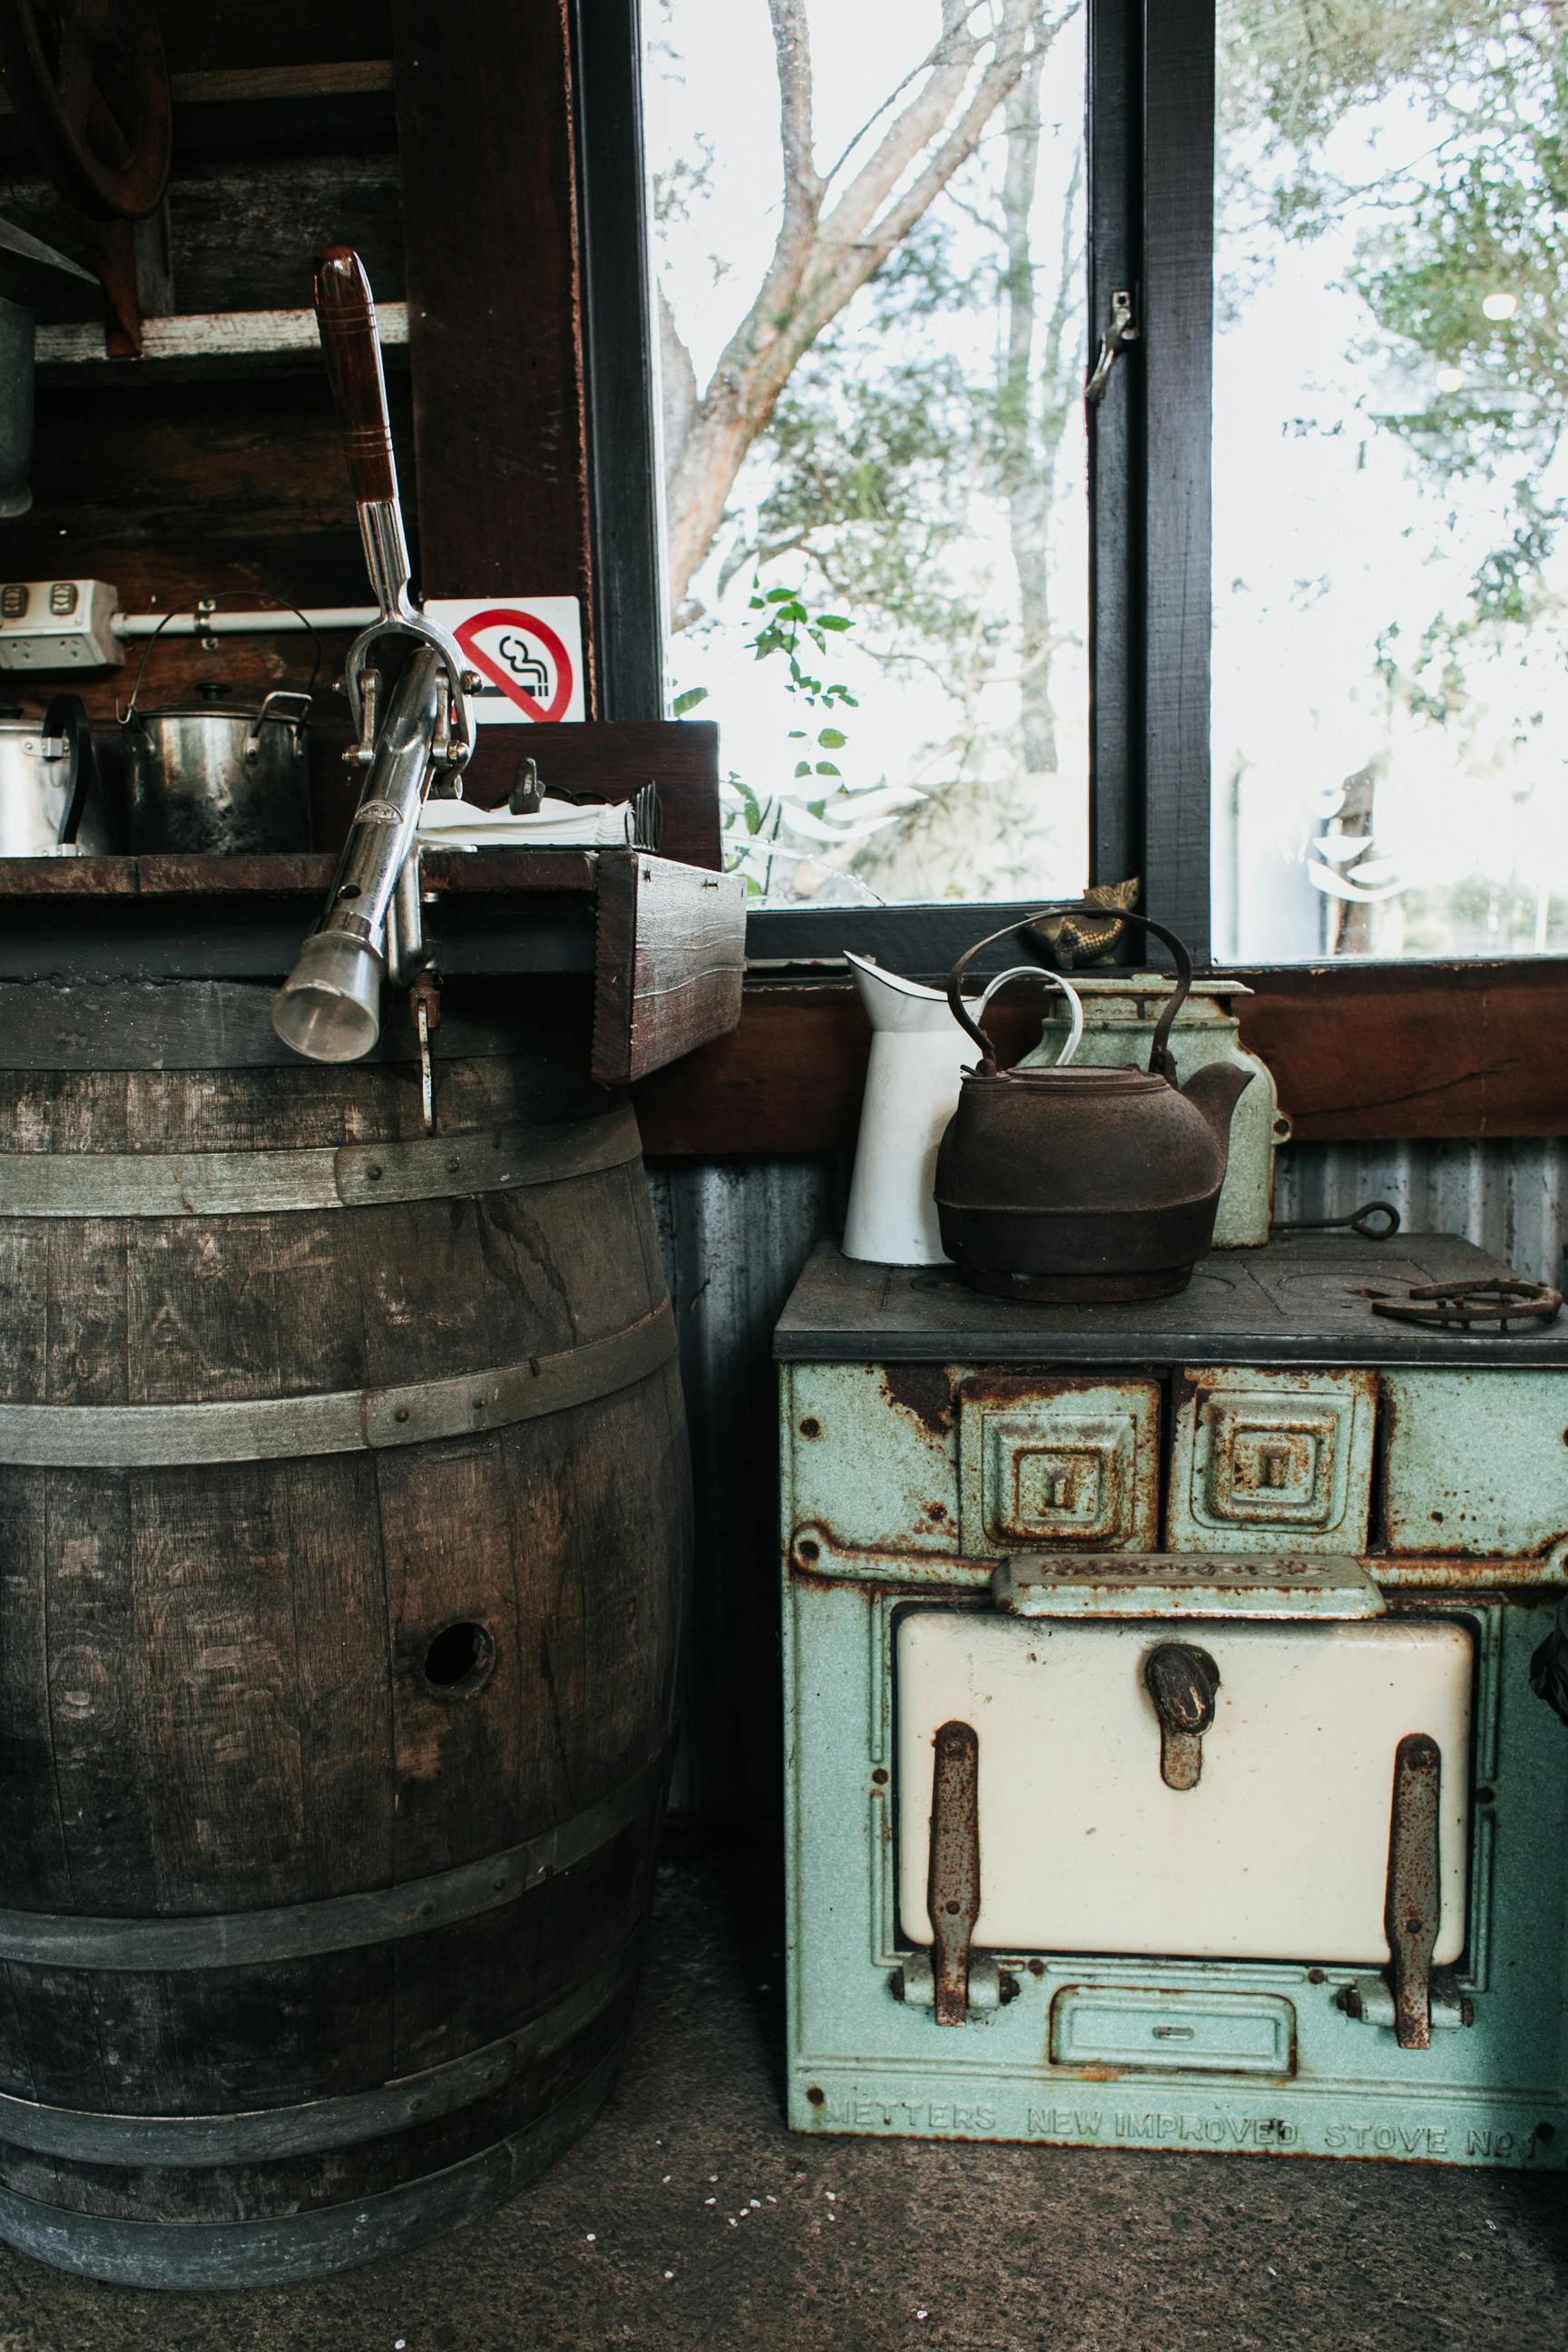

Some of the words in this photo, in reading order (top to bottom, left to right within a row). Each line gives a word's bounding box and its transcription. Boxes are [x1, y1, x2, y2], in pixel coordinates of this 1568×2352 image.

[825, 2102, 996, 2131] METTERS
[1027, 2108, 1102, 2137] NEW
[1115, 2113, 1298, 2145] IMPROVED
[1324, 2122, 1447, 2153] STOVE
